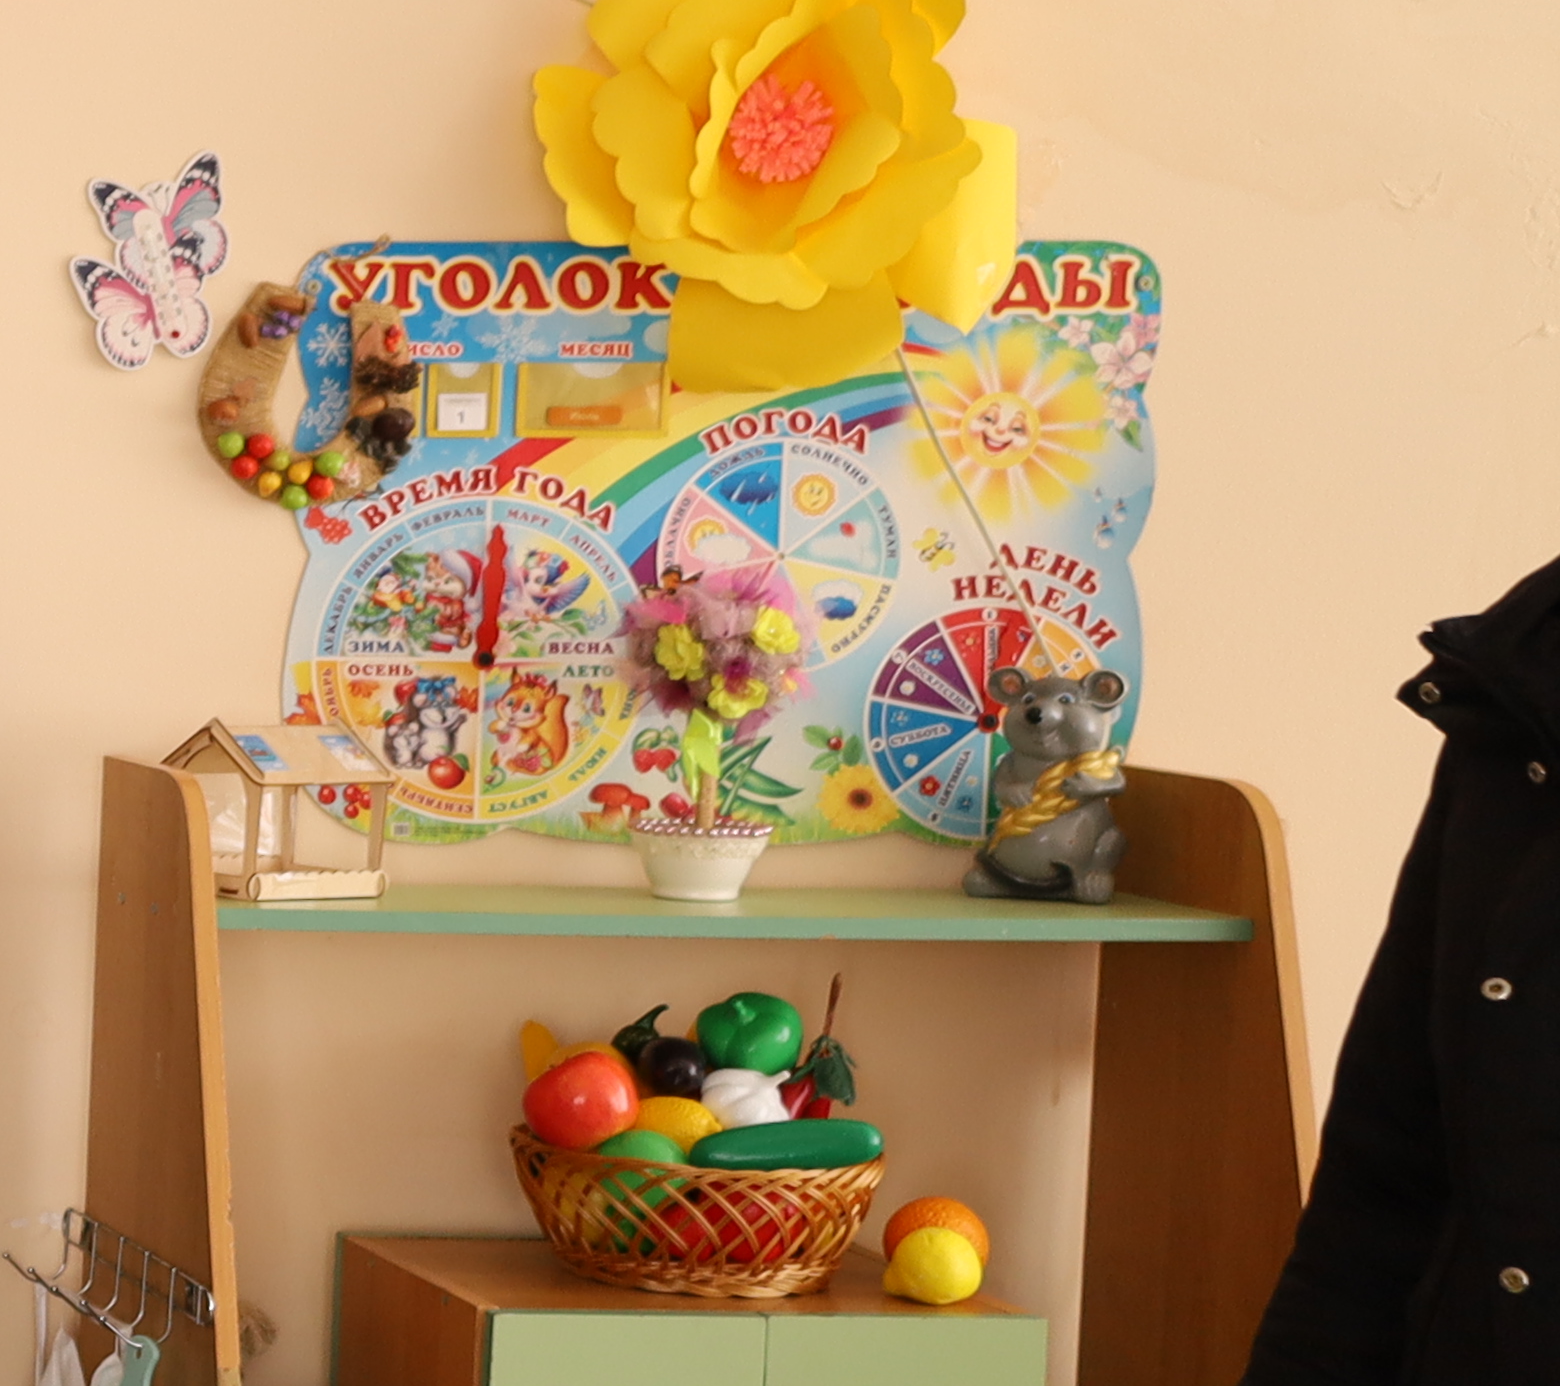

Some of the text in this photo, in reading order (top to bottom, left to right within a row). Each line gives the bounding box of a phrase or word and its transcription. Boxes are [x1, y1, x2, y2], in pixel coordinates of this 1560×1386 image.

[326, 259, 674, 312] УГОЛОК
[406, 343, 462, 357] ИСЛО
[559, 342, 632, 358] МЕСЯЦ
[700, 410, 869, 454] ПОГОДА
[709, 447, 765, 478] ДОЖДЬ
[790, 443, 868, 486] СОЛНЕЧНО
[357, 467, 616, 532] ВРЕМЯ ГОДА
[410, 505, 486, 532] ФЕВРАЛЬ
[507, 508, 551, 527] МАРТ
[878, 504, 897, 559] ТУМАН
[353, 532, 404, 580] ЯНВАРЬ
[570, 534, 618, 583] АПРЕЛЬ
[989, 543, 1100, 597] ДЕНЬ
[325, 584, 353, 654] ДЕКАБРЬ
[831, 583, 891, 653] ПАСМУРНО
[951, 574, 1119, 650] НЕДЕЛИ
[348, 640, 405, 654] ЗИМА
[548, 641, 615, 655] ВЕСНА
[348, 663, 414, 677] ОСЕНЬ
[561, 664, 615, 678] ЛЕТО
[322, 667, 340, 717] ОЯБРЬ
[568, 747, 607, 782] ИЮЛЬ
[400, 786, 474, 813] СЕНТЯБРЬ
[488, 789, 548, 812] АВГУСТ
